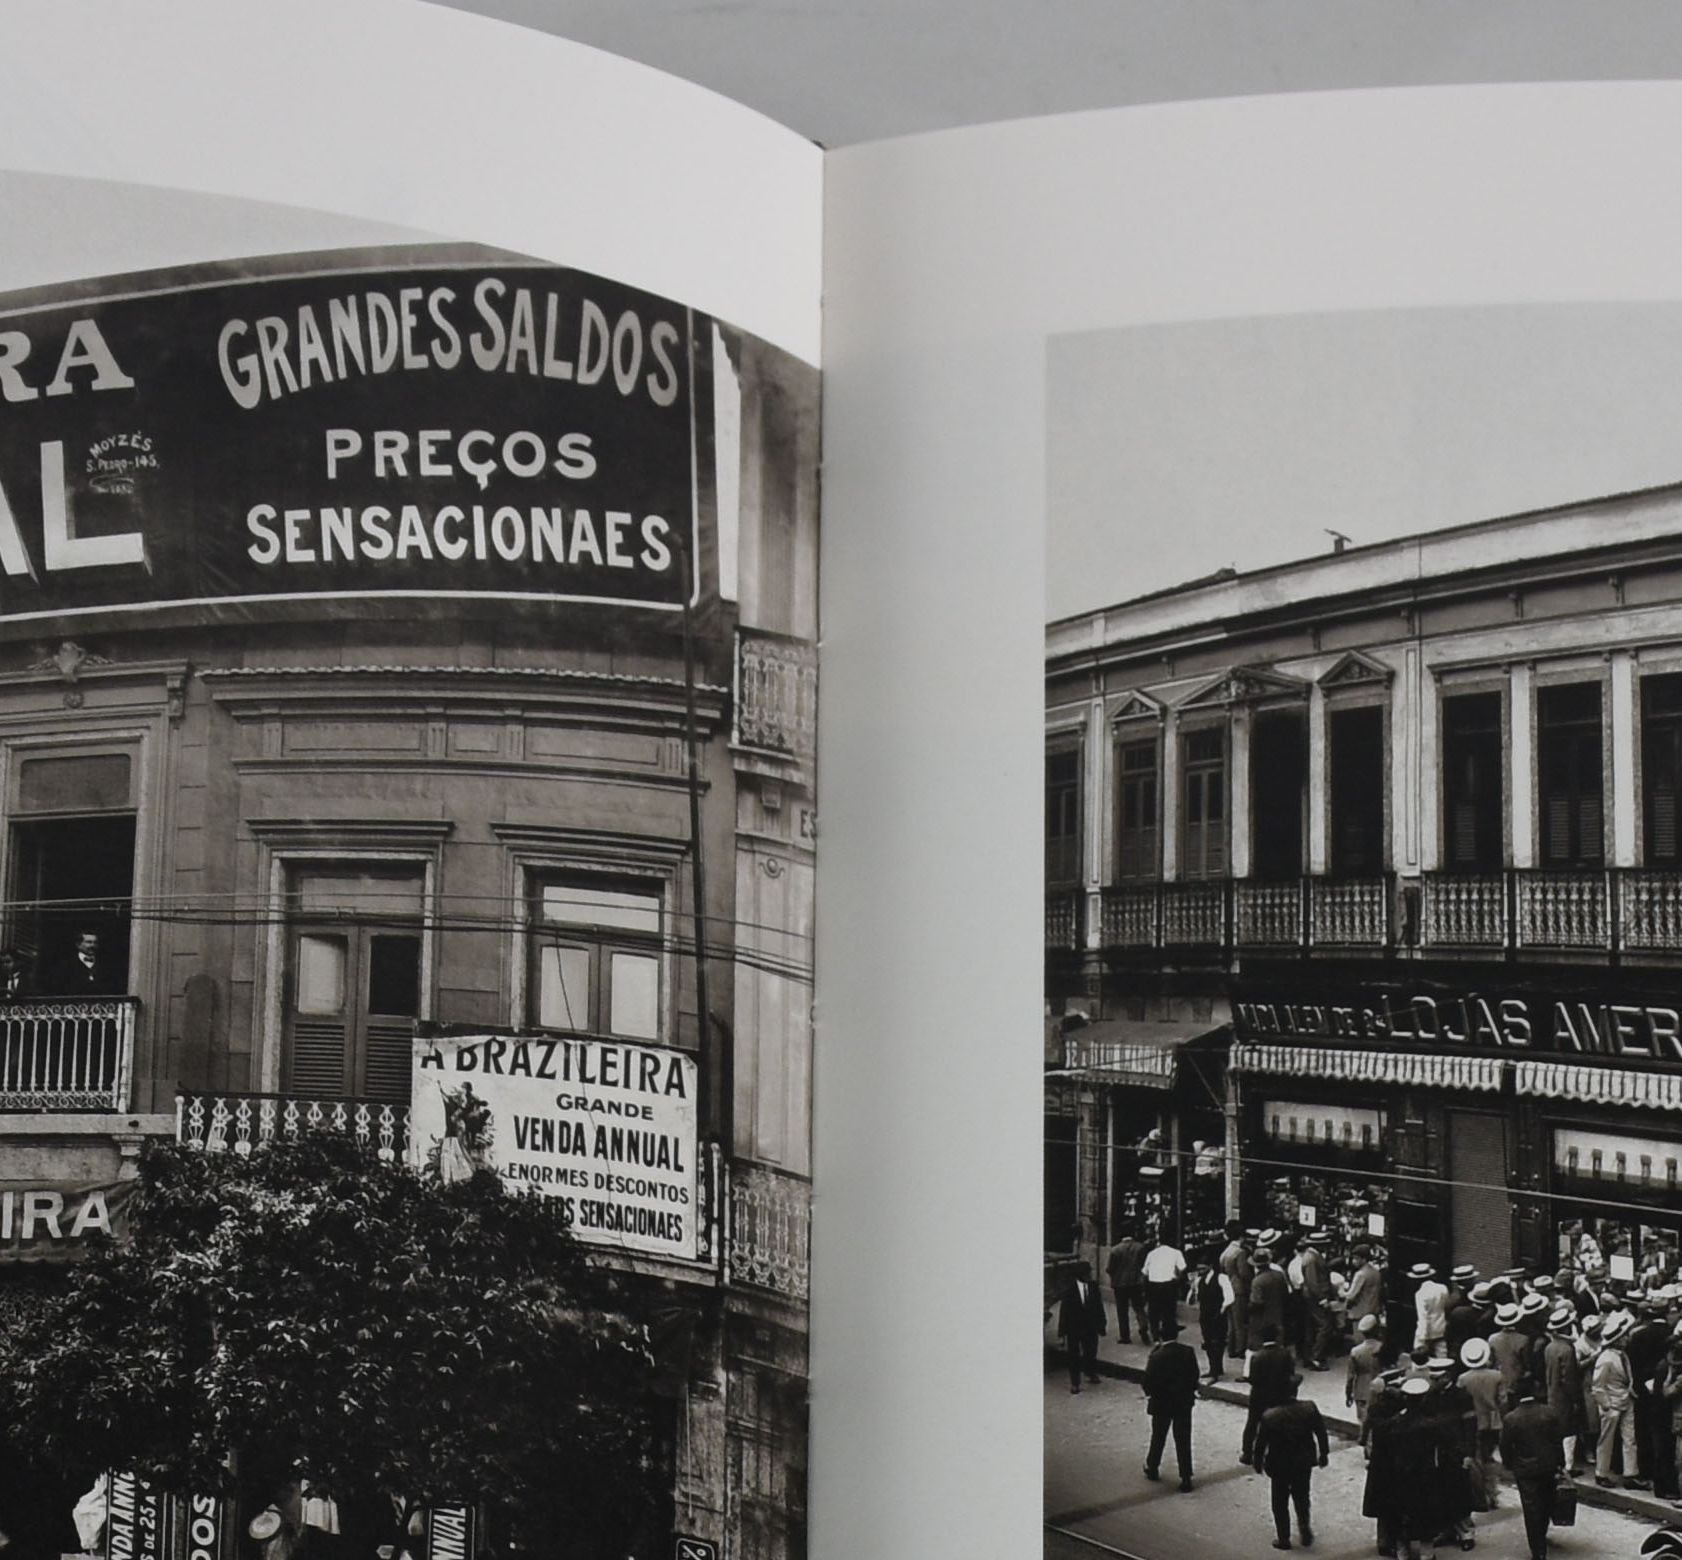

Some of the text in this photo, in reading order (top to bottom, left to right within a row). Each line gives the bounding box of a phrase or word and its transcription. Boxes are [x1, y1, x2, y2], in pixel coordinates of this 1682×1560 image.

[217, 277, 679, 409] GRANDES SALDOS
[325, 429, 598, 490] PREÇOS
[246, 503, 672, 572] SENSACIONAES
[1380, 993, 1532, 1046] LOJAS
[456, 1037, 686, 1099] BRAZILEIRA
[556, 1093, 654, 1121] GRANDE
[513, 1115, 684, 1173] VENDA ANNUAL
[508, 1162, 689, 1205] ENORMES DESCONTOS
[580, 1199, 683, 1243] SENSACIONAES
[139, 1506, 157, 1530] 25
[143, 1533, 156, 1550] DE
